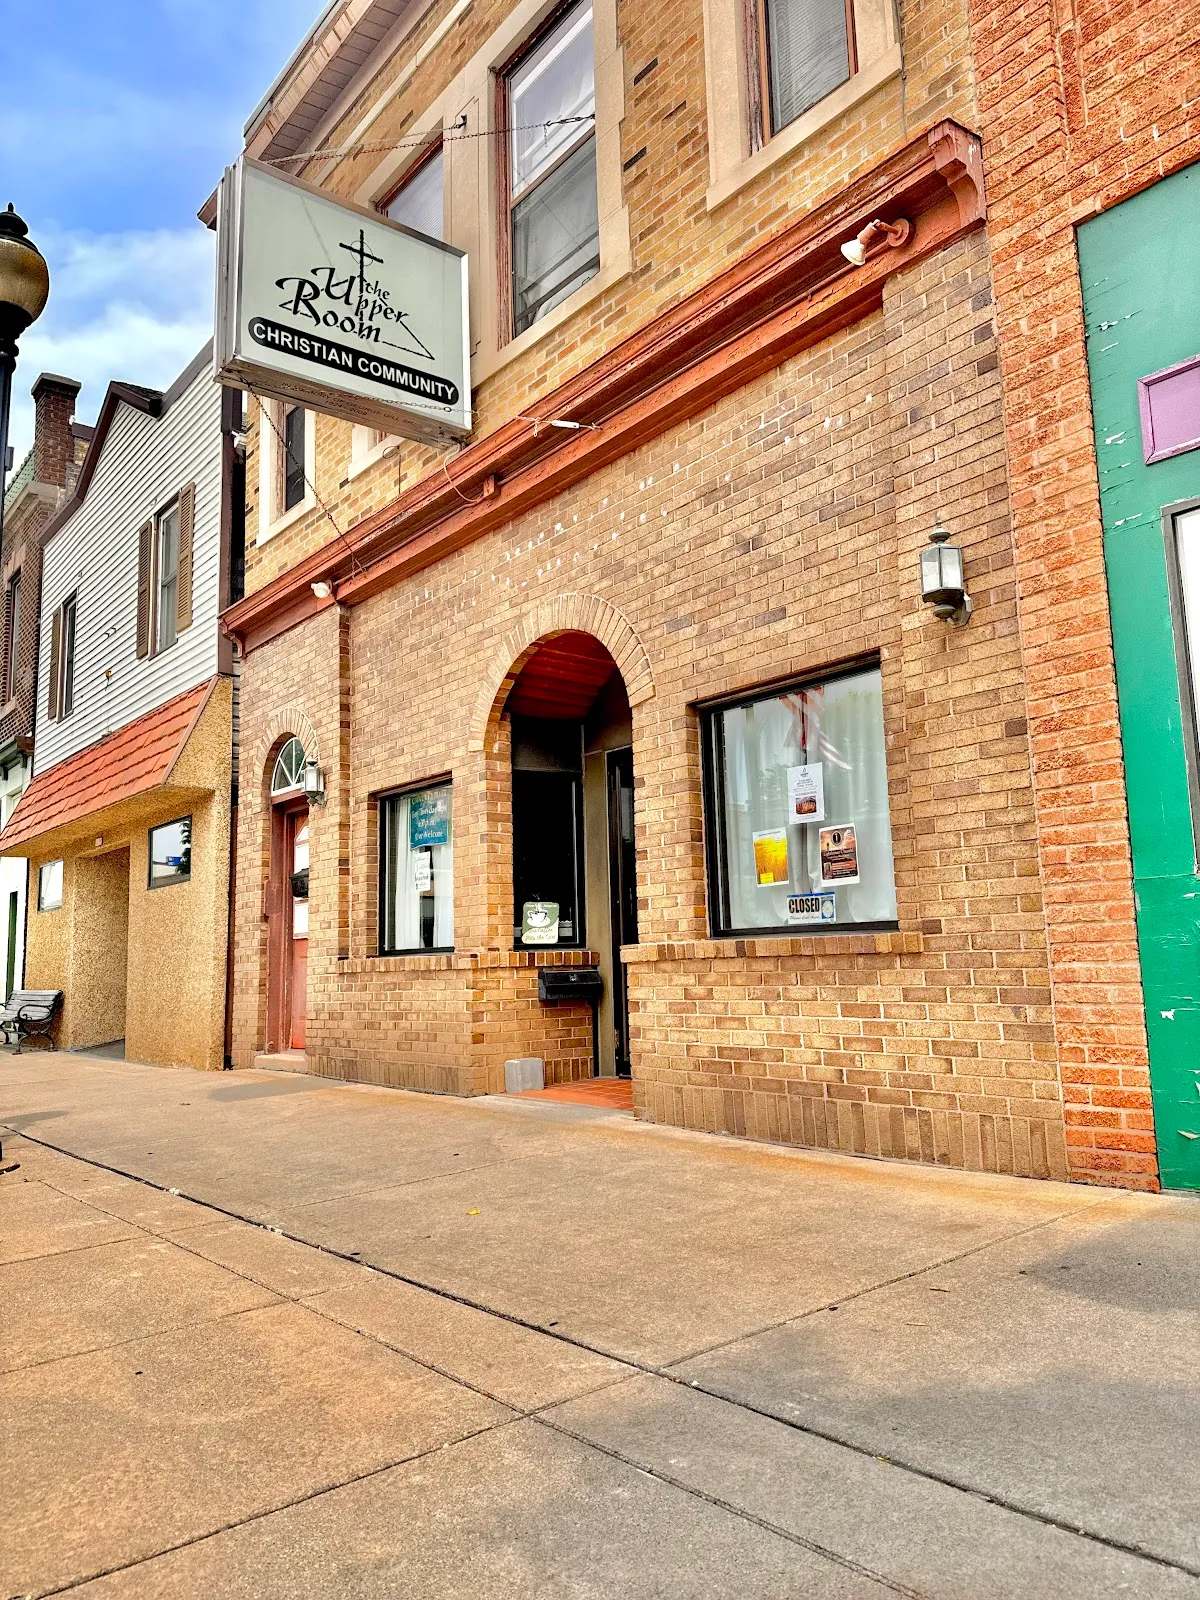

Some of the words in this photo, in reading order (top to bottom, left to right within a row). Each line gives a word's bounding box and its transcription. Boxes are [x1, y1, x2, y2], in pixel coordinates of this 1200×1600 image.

[275, 277, 381, 343] Room
[310, 266, 409, 323] Upper
[365, 280, 391, 300] the
[252, 322, 353, 369] CHRISTIAN
[357, 357, 456, 400] COMMUNITY
[788, 897, 820, 914] CLOSED
